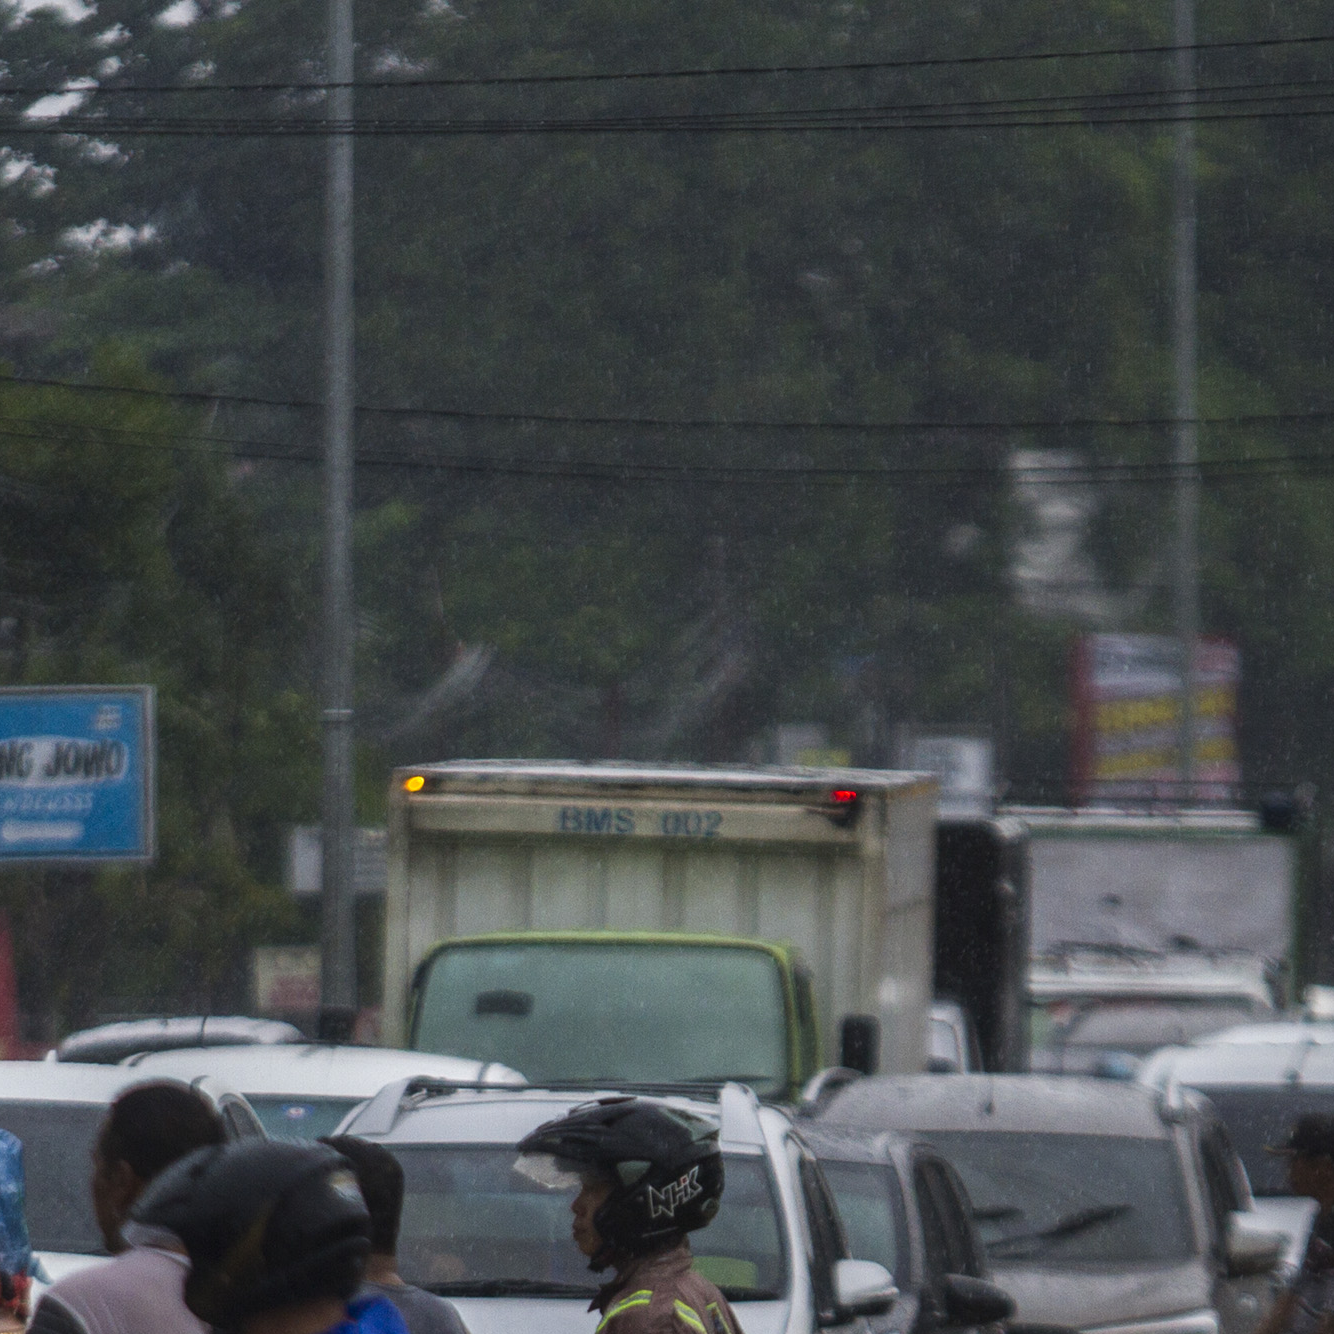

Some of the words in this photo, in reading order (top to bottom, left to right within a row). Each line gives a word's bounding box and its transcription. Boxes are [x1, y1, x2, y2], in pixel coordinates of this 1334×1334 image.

[43, 739, 124, 777] JOWO
[559, 807, 635, 834] BMS
[661, 810, 722, 837] 002
[649, 1165, 703, 1218] NHK
